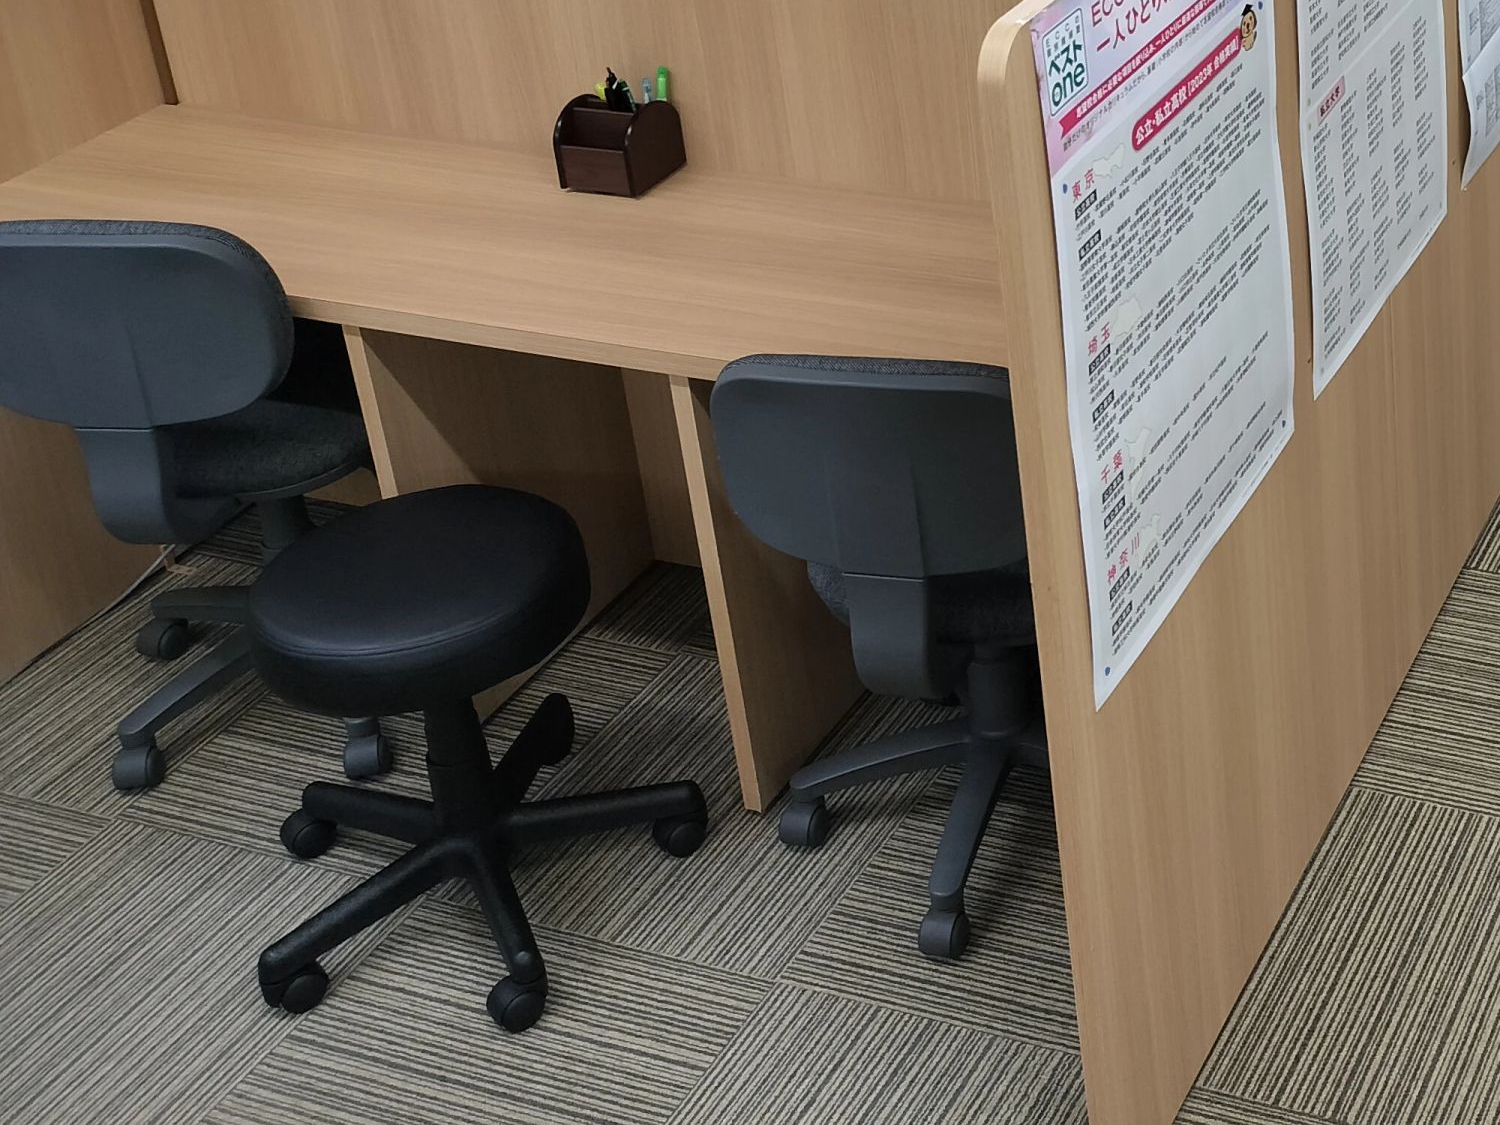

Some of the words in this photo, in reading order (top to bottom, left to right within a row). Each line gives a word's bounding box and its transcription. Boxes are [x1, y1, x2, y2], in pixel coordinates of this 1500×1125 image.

[1048, 40, 1083, 78] ベスト
[1052, 62, 1085, 107] one
[1071, 168, 1095, 203] 東京
